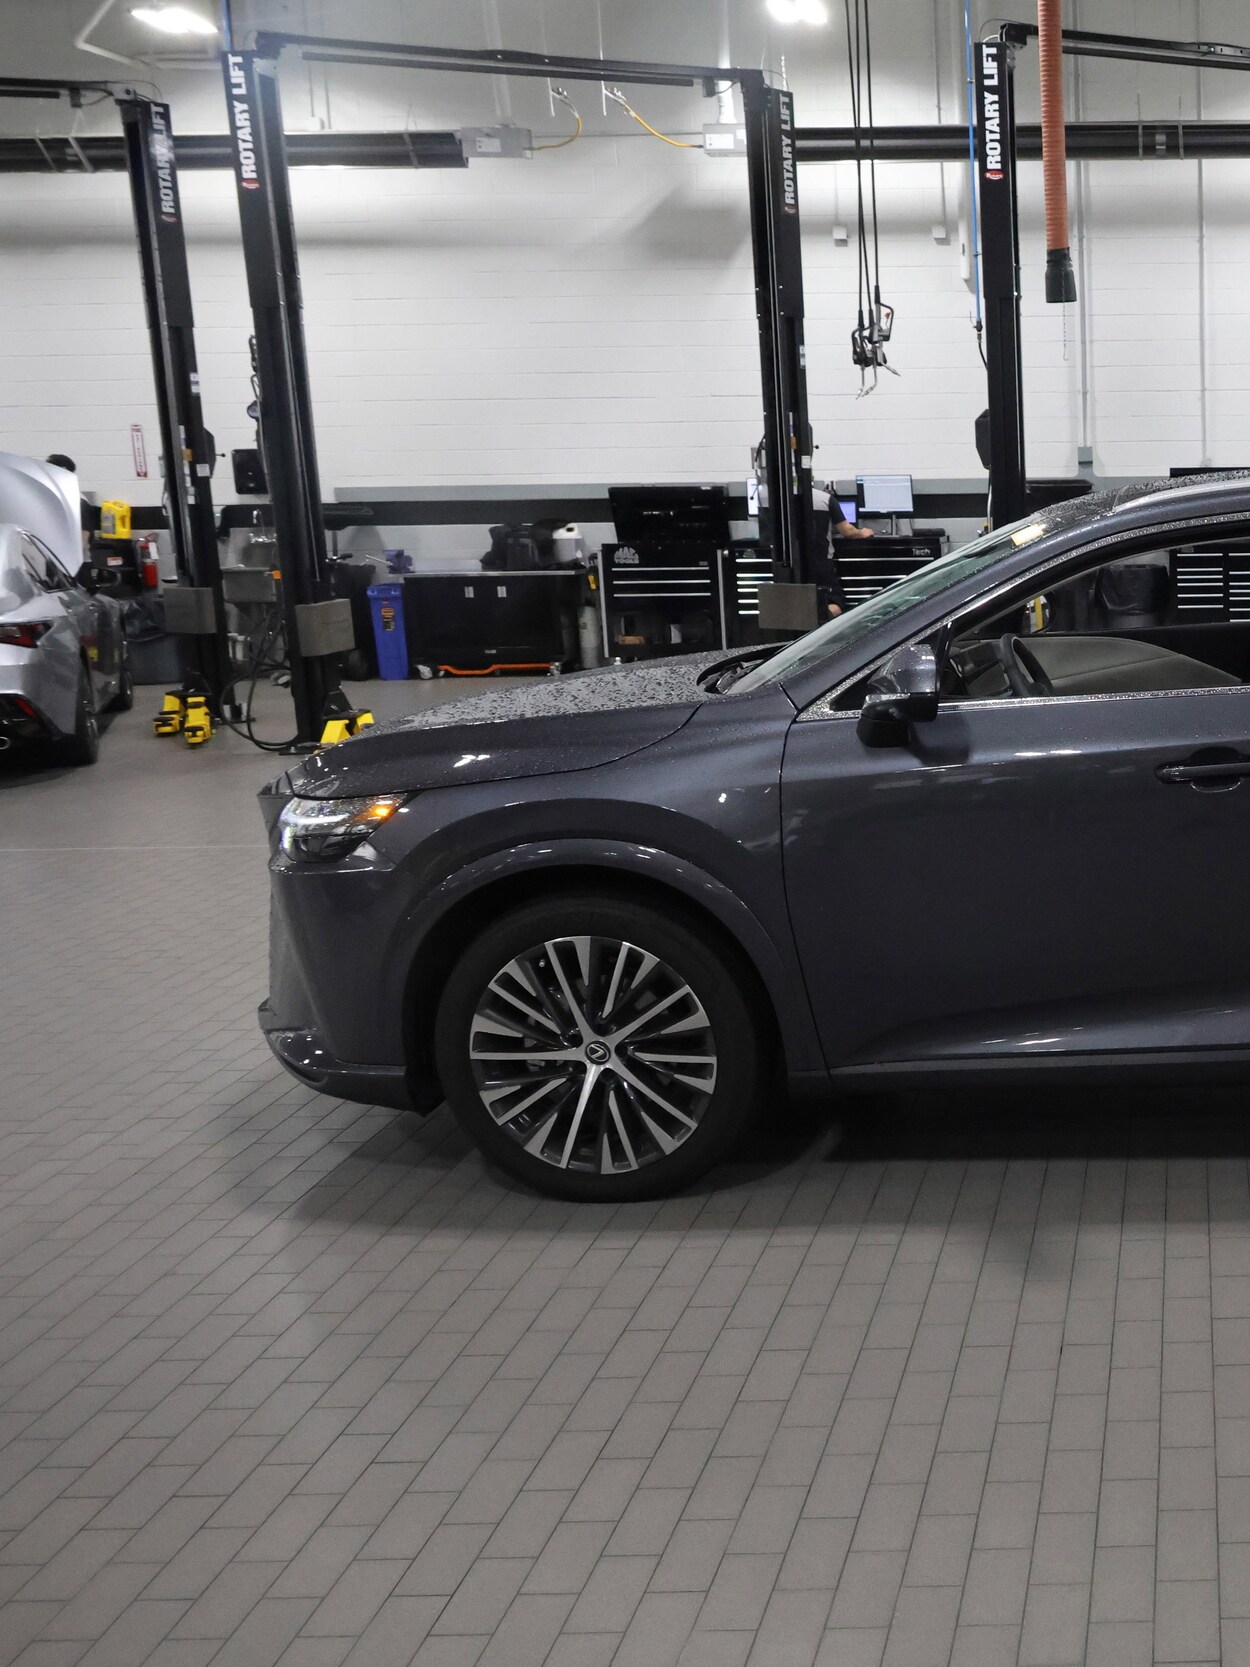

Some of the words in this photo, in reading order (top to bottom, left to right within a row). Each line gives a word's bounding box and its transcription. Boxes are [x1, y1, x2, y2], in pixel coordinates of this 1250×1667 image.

[228, 53, 247, 95] LIFT
[982, 45, 998, 85] LIFT
[233, 100, 257, 178] ROTARY
[780, 94, 791, 131] LIFT
[984, 91, 1001, 169] ROTARY
[782, 135, 795, 204] ROTARY
